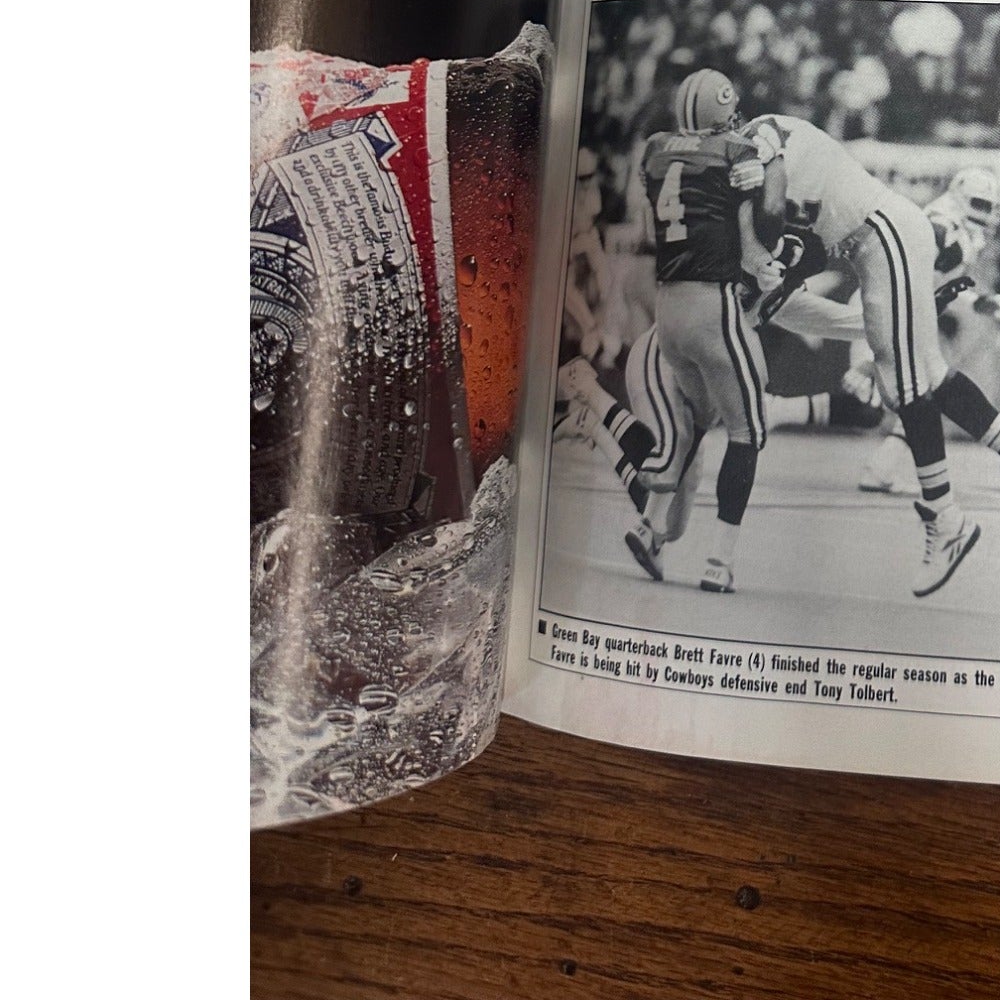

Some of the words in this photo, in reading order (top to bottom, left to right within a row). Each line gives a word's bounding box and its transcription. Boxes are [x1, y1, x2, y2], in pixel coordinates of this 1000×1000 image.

[657, 161, 688, 243] 4
[551, 645, 575, 665] Favre
[580, 651, 589, 667] is
[594, 654, 621, 676] being
[626, 659, 641, 677] hit
[646, 663, 659, 683] by
[664, 666, 714, 689] Cowboys
[720, 673, 778, 693] defensive
[785, 679, 807, 695] end
[814, 680, 842, 701] Tony
[849, 683, 897, 702] Tolbert.
[552, 623, 578, 643] Green
[582, 629, 600, 650] Bay
[605, 638, 668, 658] quarterback
[674, 644, 704, 663] Brett
[710, 648, 742, 667] Favre
[748, 652, 765, 672] (4)
[771, 654, 820, 673] finished
[827, 659, 846, 675] the
[853, 662, 897, 680] regular
[903, 669, 947, 683] season
[954, 672, 967, 685] as
[975, 670, 995, 687] the
